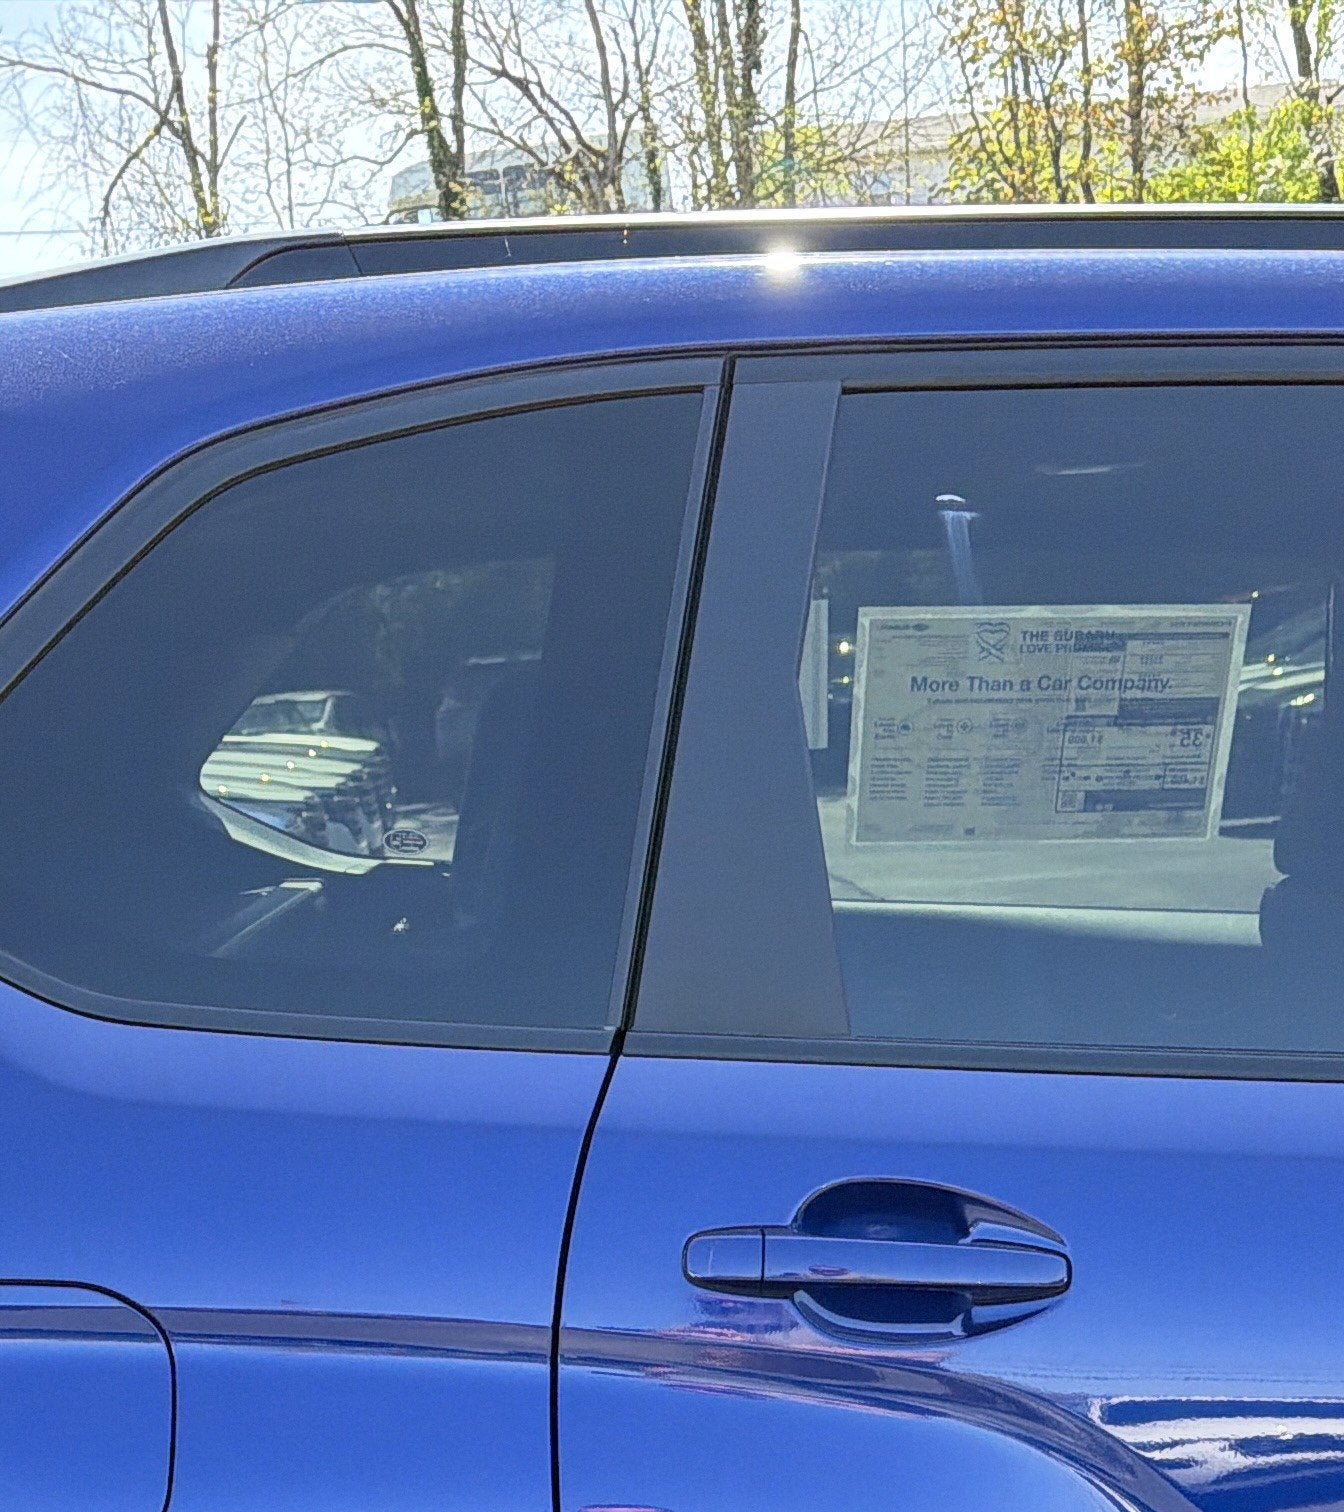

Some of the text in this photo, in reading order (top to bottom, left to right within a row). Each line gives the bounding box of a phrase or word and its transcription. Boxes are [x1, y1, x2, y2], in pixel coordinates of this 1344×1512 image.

[1020, 630, 1049, 642] THE
[1019, 643, 1053, 653] LOVE
[910, 676, 960, 692] More
[967, 676, 1014, 692] Than
[1019, 679, 1032, 692] a
[1037, 675, 1072, 692] Car
